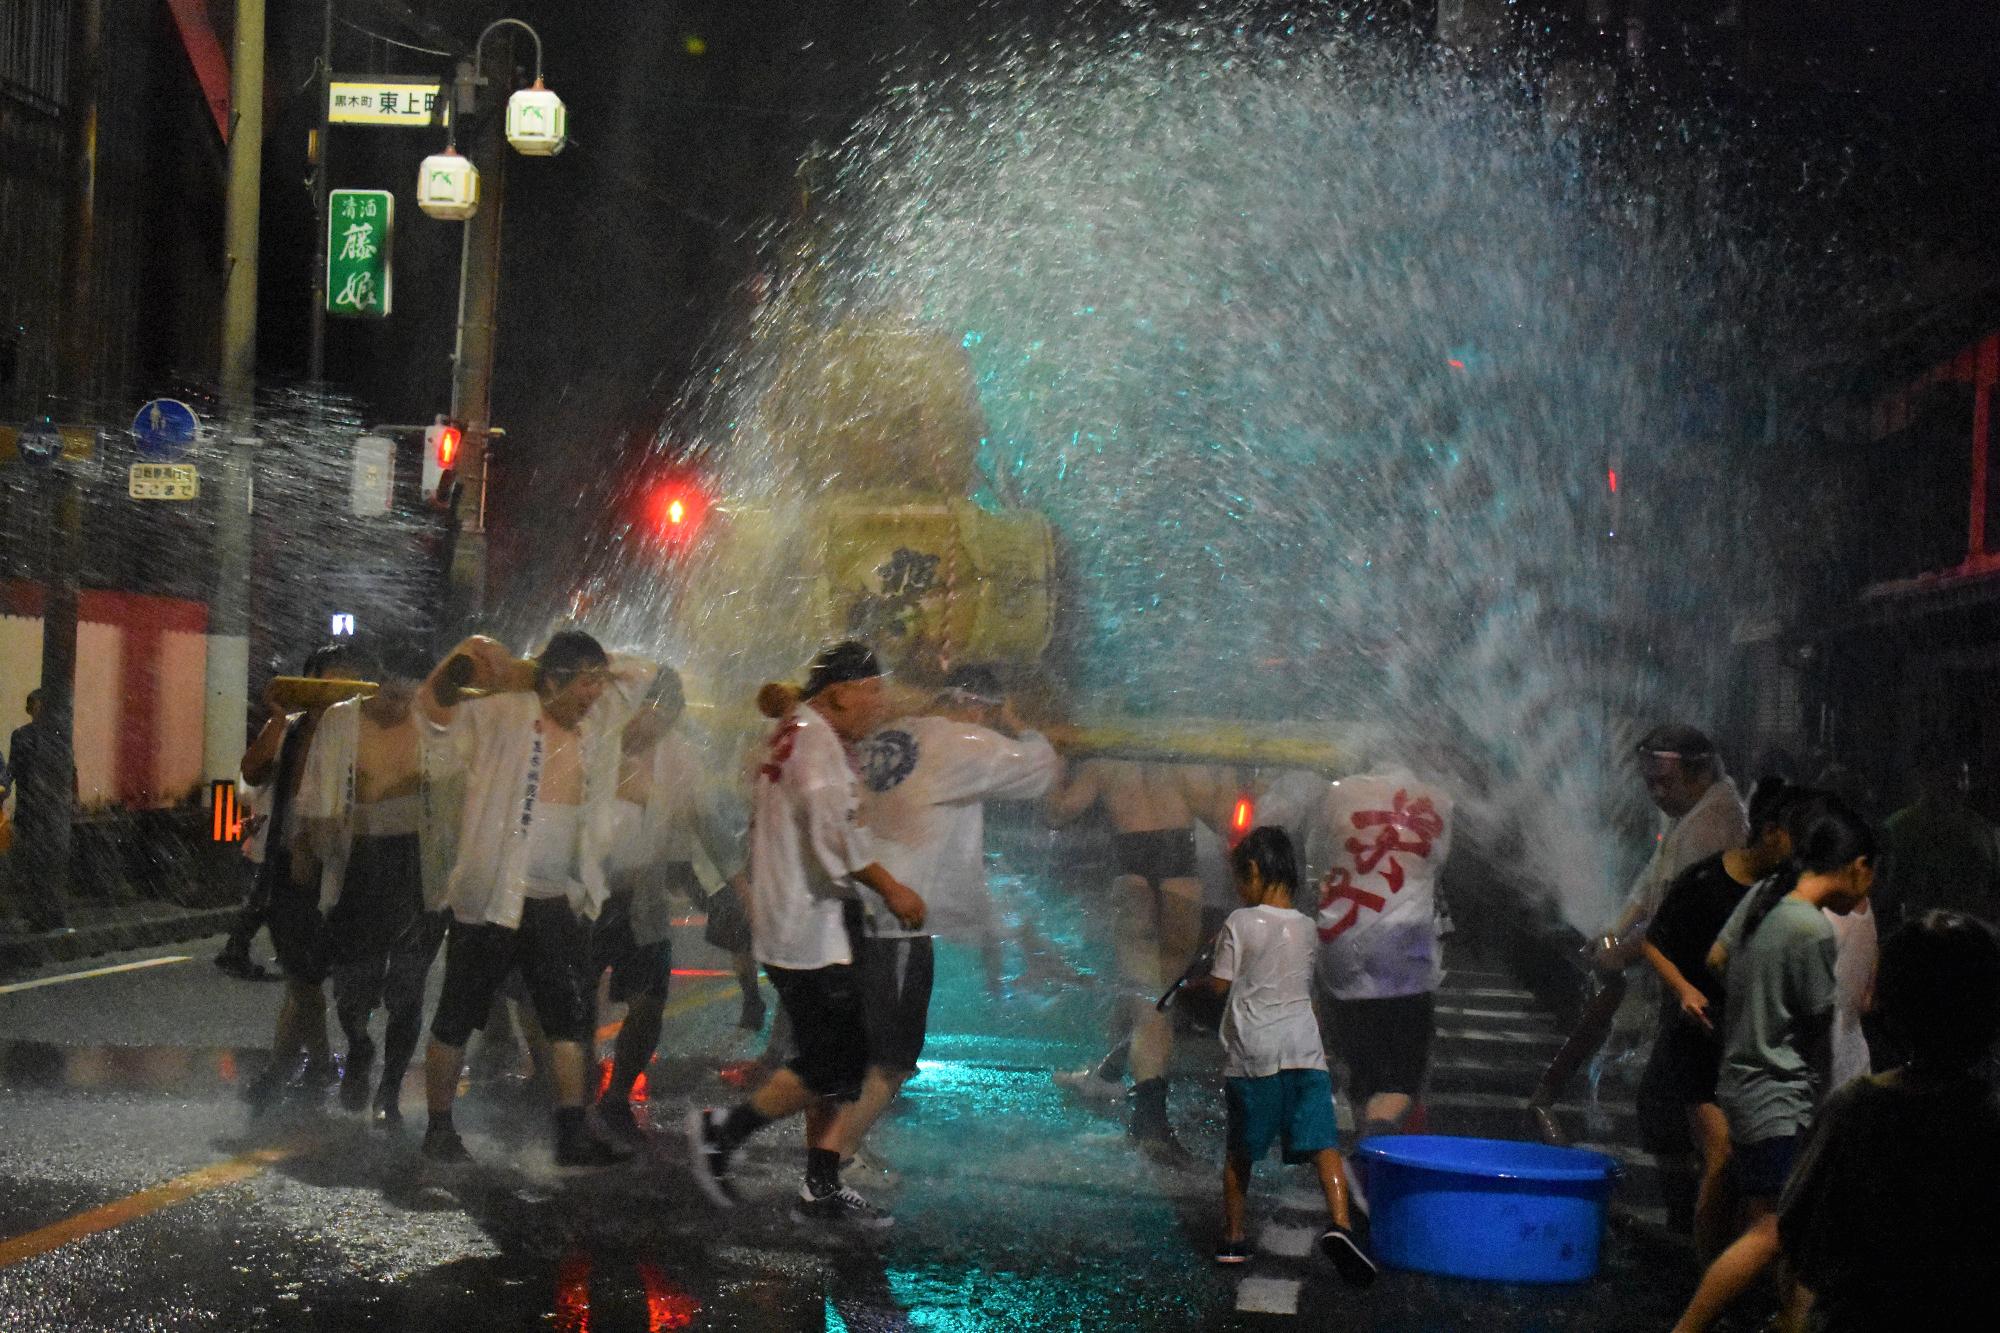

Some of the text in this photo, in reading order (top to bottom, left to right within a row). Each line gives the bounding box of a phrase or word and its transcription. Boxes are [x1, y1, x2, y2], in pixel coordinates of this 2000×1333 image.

[334, 94, 373, 108] 黒木町
[341, 196, 377, 220] 清酒
[133, 483, 192, 497] ここまで
